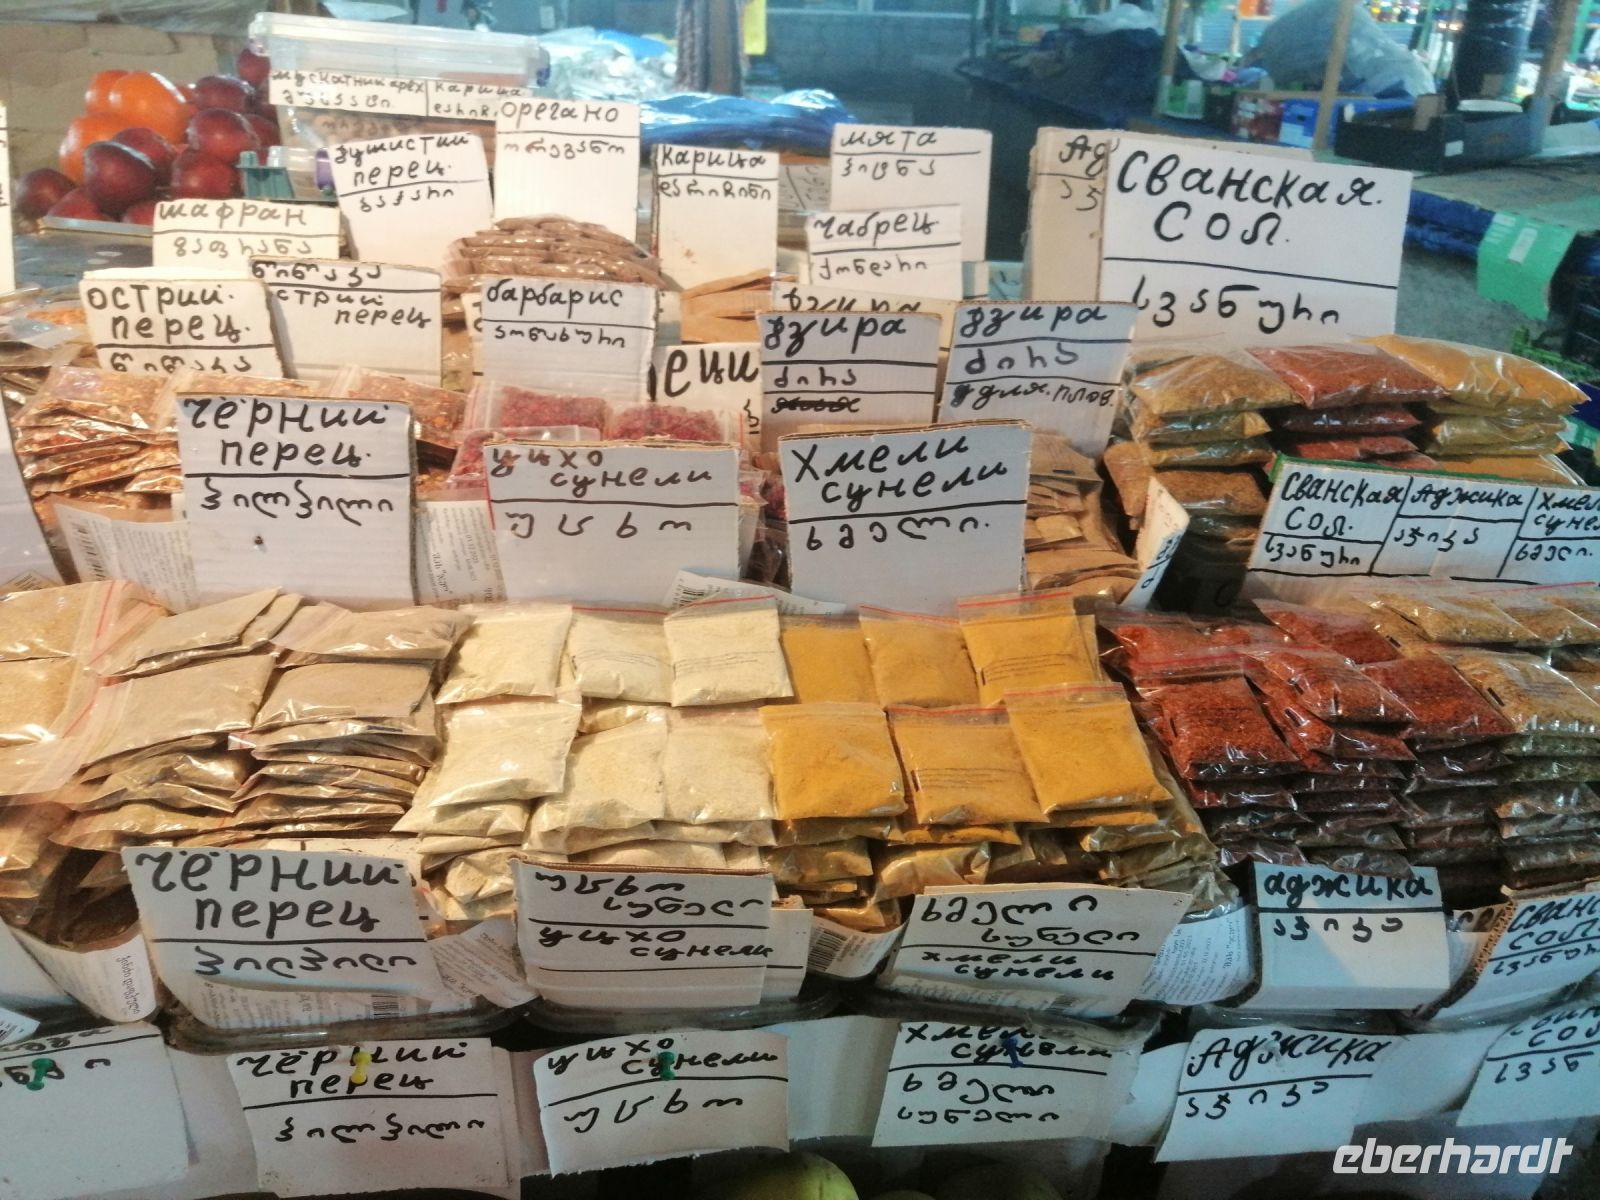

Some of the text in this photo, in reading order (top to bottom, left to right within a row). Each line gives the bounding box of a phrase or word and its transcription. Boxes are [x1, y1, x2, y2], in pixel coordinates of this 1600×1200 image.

[841, 130, 937, 151] мята
[159, 203, 307, 228] шафран
[275, 289, 383, 307] стрий
[487, 278, 623, 318] барбарис
[1132, 275, 1340, 334] სვანური
[335, 307, 431, 328] перец
[491, 448, 603, 477] уцхо
[792, 435, 969, 482] Хмели
[550, 467, 712, 498] сунели
[822, 462, 1007, 512] сунели
[1281, 471, 1402, 508] Сванская
[1410, 483, 1523, 510] Аджика
[201, 477, 393, 526] პილპილი
[505, 511, 692, 539] უცხო
[535, 871, 685, 896] უცხო
[1264, 872, 1433, 907] аджика
[195, 897, 380, 939] перец
[921, 895, 1098, 926] ხმელი
[539, 926, 686, 946] уцхо
[981, 926, 1140, 947] სუნელი
[629, 944, 774, 961] сунели
[548, 1038, 674, 1075] уцхо
